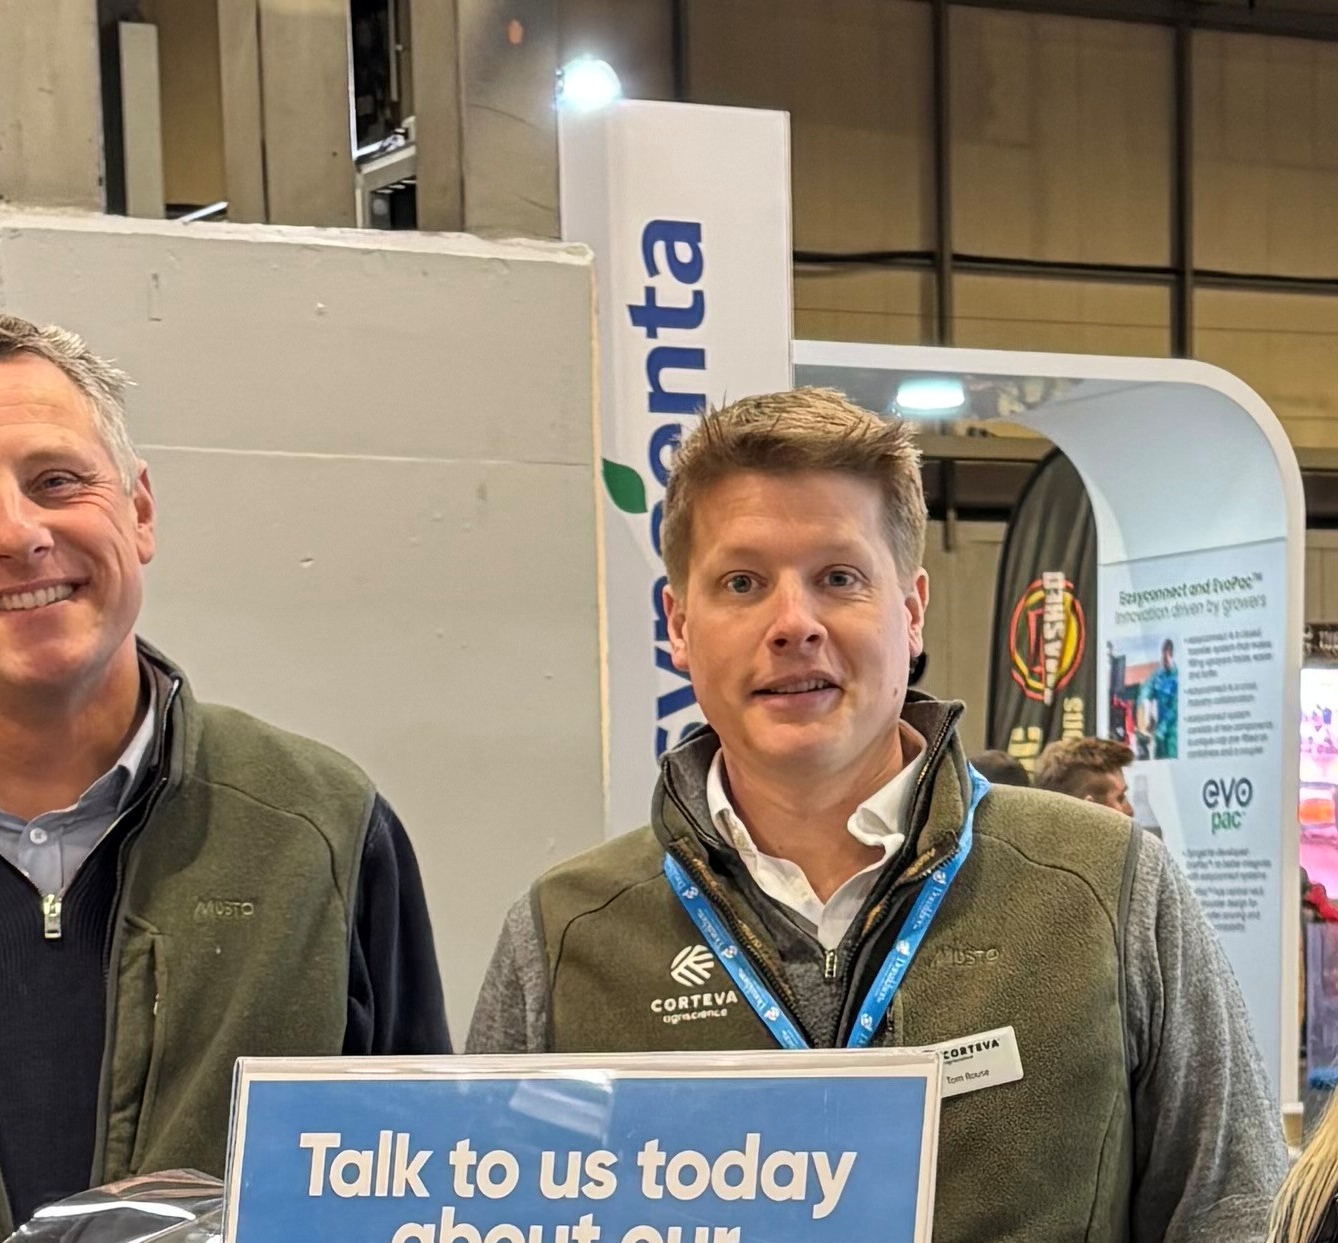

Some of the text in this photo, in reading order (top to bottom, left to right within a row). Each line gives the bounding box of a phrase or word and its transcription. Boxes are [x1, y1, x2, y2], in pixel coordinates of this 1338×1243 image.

[1203, 777, 1253, 809] evo
[1211, 811, 1242, 834] pac
[650, 990, 739, 1014] CORTEVA
[943, 1038, 1000, 1060] CORTEVA
[299, 1131, 857, 1219] Talk to us today
